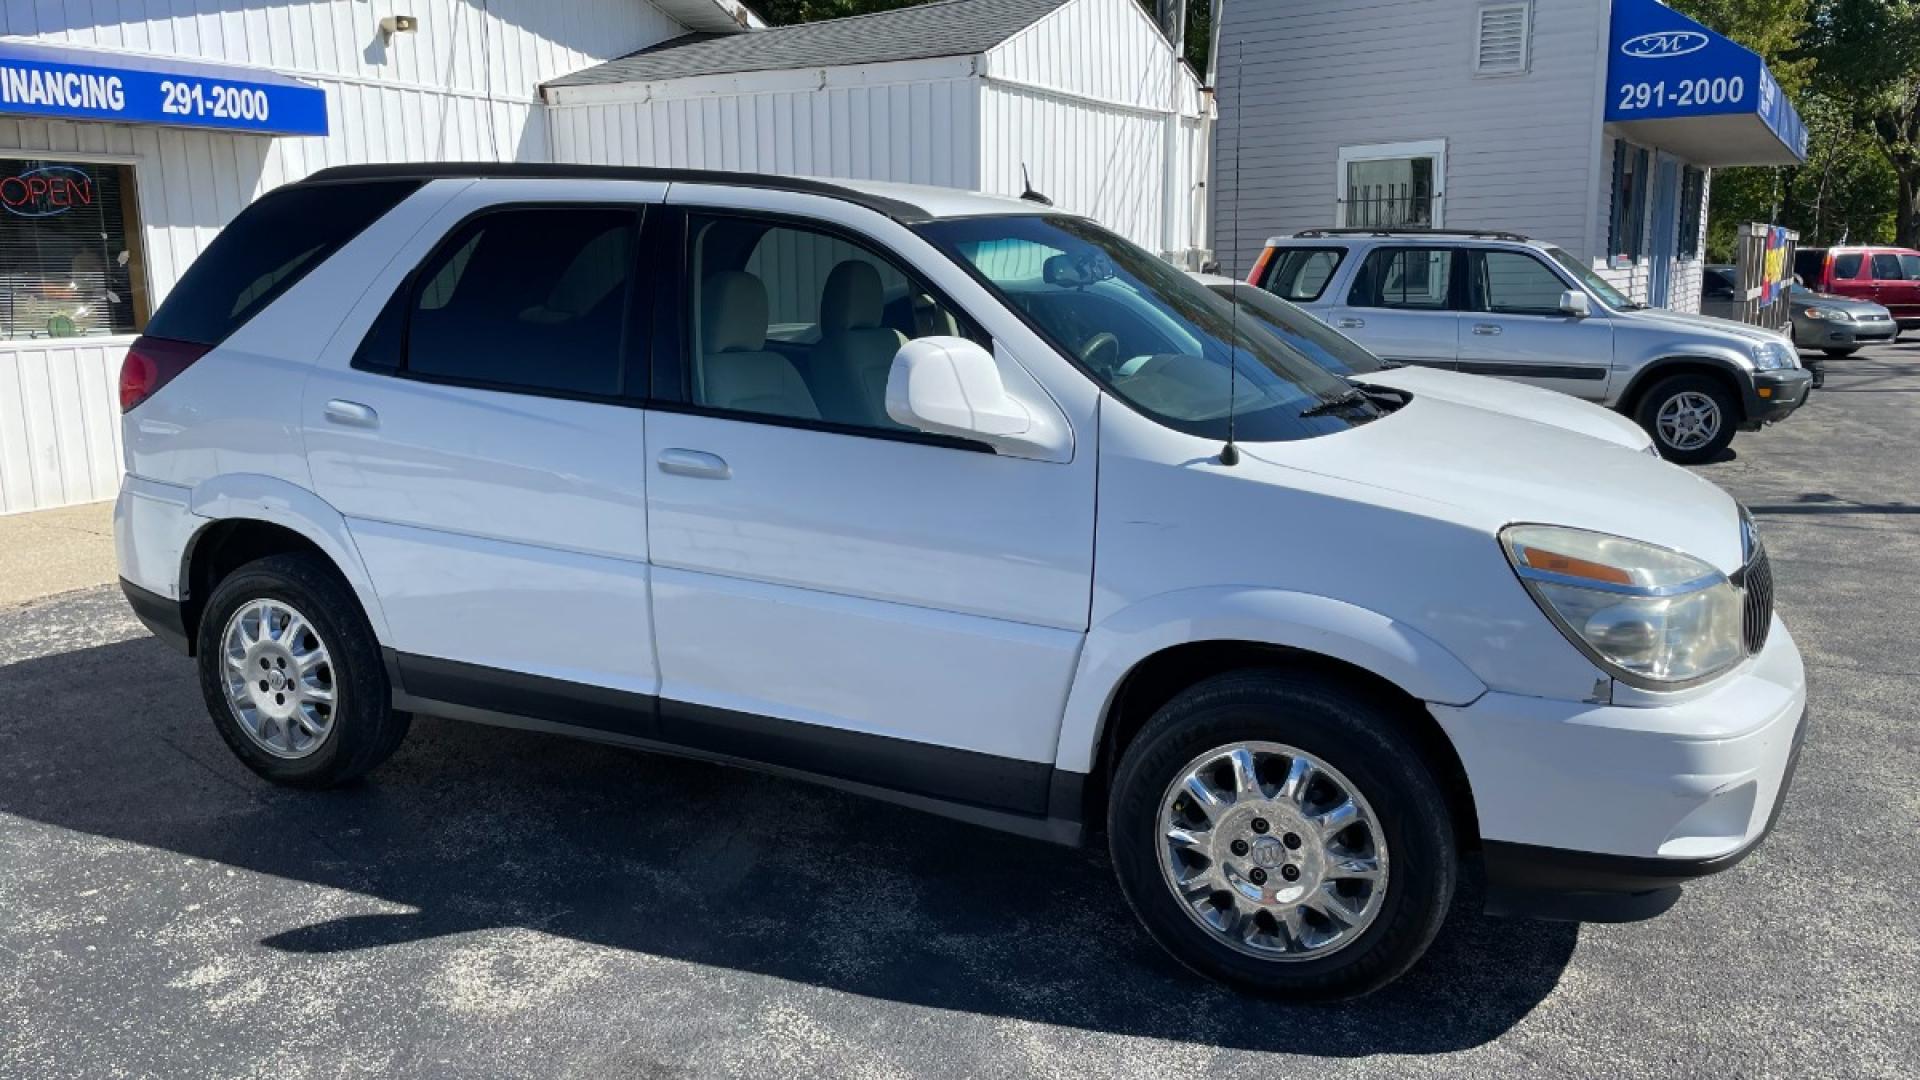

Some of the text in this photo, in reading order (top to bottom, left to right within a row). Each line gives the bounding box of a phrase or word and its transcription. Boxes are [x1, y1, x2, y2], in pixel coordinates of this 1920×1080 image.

[0, 66, 269, 121] INANCING 291-2000
[1618, 76, 1744, 110] 291-2000
[0, 176, 92, 206] OPEN
